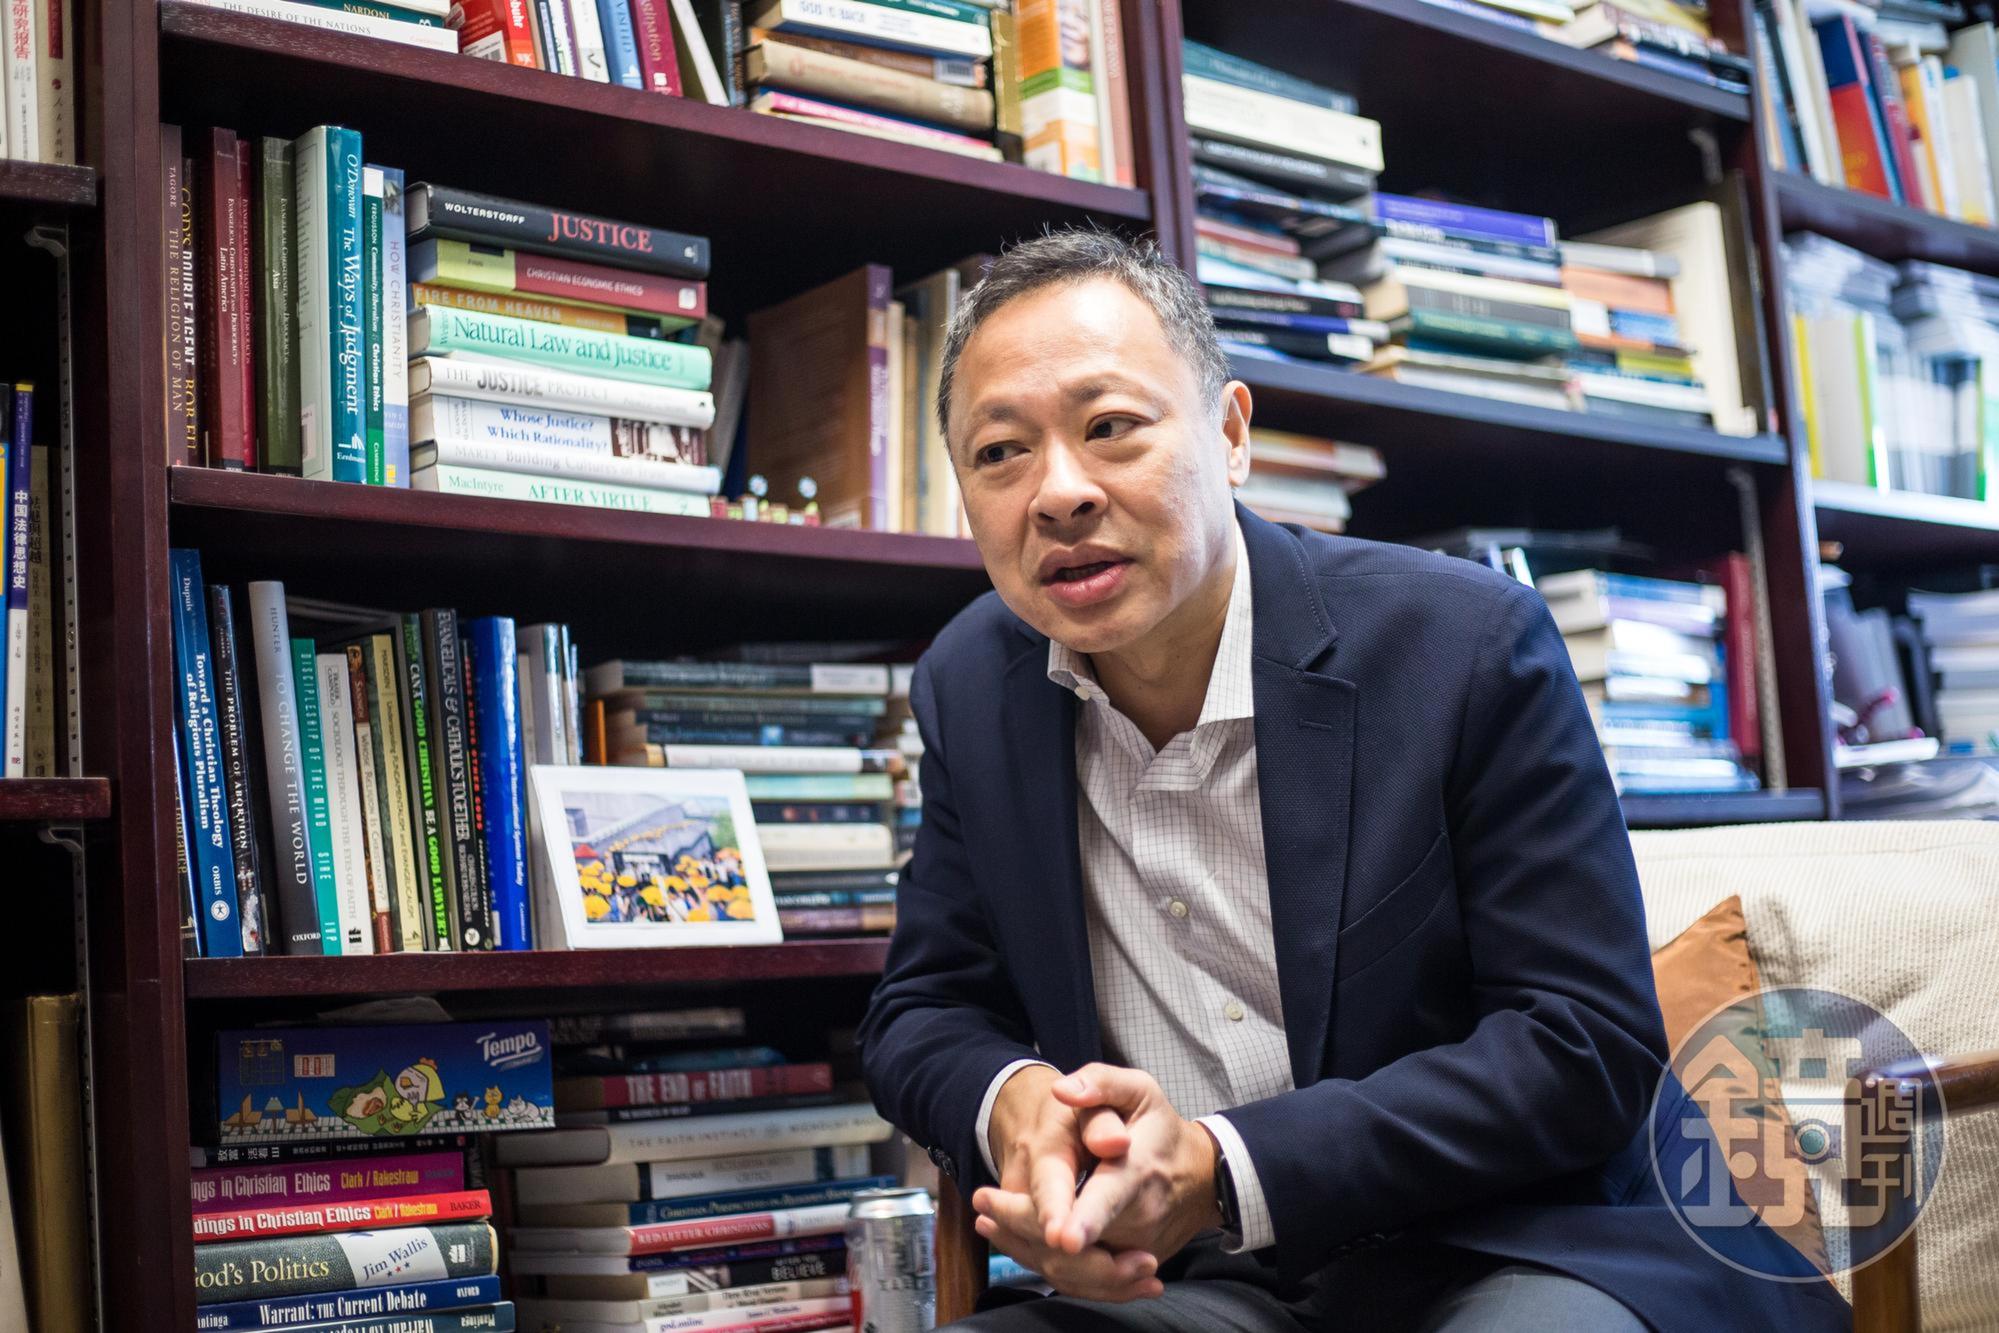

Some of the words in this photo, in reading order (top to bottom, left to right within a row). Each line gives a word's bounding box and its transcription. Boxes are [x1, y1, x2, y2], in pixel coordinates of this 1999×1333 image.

[12, 0, 31, 60] 研究报告
[222, 1, 244, 11] THE
[246, 6, 282, 20] DESIRE
[285, 12, 300, 21] OF
[302, 14, 322, 26] THE
[325, 18, 371, 35] NATIONS
[168, 165, 178, 208] TAGORE
[347, 153, 359, 218] O'Donovan
[444, 202, 525, 224] WOLTERSTORFF
[169, 228, 179, 260] THE
[343, 227, 355, 251] The
[548, 212, 653, 253] JUSTICE
[219, 247, 228, 271] Latin
[390, 241, 401, 275] HOW
[220, 273, 229, 313] America
[272, 268, 281, 289] Asia
[338, 254, 360, 302] Ways
[526, 267, 571, 284] CHRISTIAN
[572, 277, 614, 292] ECONOMIC
[614, 282, 643, 296] ETHICS
[170, 267, 181, 343] RELIGION
[345, 305, 357, 321] of
[415, 287, 451, 304] FIRE
[457, 293, 499, 310] FROM
[505, 300, 561, 320] HEAVEN
[391, 280, 402, 377] CHRISTIANITY
[453, 315, 525, 346] Natural
[530, 327, 571, 354] Law
[575, 335, 610, 360] and
[614, 342, 672, 371] Justice
[171, 350, 182, 371] OF
[338, 322, 361, 416] Judgment
[372, 343, 380, 384] Christian
[172, 376, 183, 412] MAN
[373, 385, 381, 412] Ethics
[446, 368, 471, 382] THE
[477, 370, 544, 397] JUSTICE
[499, 407, 543, 424] Whose
[546, 415, 594, 431] Justice?
[487, 425, 530, 441] Which
[533, 432, 608, 451] Rationality?
[506, 452, 560, 471] Building
[448, 474, 504, 493] MacIntyre
[528, 484, 585, 503] AFTER
[590, 491, 653, 512] VIRTUE
[13, 490, 28, 588] 中国法律思想史
[182, 577, 193, 612] Dupuis
[270, 607, 281, 654] HUNTER
[438, 612, 457, 695] EVANGELICALS
[186, 673, 197, 689] of
[195, 652, 210, 703] Toward
[224, 669, 233, 692] THE
[275, 673, 286, 694] TO
[410, 663, 421, 689] CAN
[300, 653, 319, 739] DISCIPLESHIP
[445, 697, 458, 713] &
[188, 692, 202, 757] Religious
[226, 697, 239, 757] PROBLEM
[414, 699, 426, 737] GOOD
[203, 718, 218, 783] Christian
[278, 701, 296, 775] CHANGE
[308, 747, 321, 761] OF
[332, 711, 343, 768] SOCIOLOGY
[446, 715, 464, 781] CATHOLICS
[232, 761, 241, 777] OF
[311, 769, 323, 790] THE
[381, 649, 391, 689] MARSDEN
[390, 755, 406, 831] FUNDAMENTALISM
[400, 848, 415, 919] EVANGELICALISM
[418, 740, 433, 807] CHRISTIAN
[194, 760, 208, 829] Pluralism
[286, 781, 301, 814] THE
[337, 771, 348, 823] THROUGH
[209, 786, 224, 848] Theology
[234, 781, 247, 850] ABORTION
[313, 797, 327, 827] MIND
[425, 809, 435, 825] BE
[452, 781, 470, 842] TOGETHER
[341, 825, 351, 846] THE
[427, 824, 437, 835] A
[291, 821, 307, 885] WORLD
[317, 852, 331, 880] SIRE
[344, 848, 354, 872] EYES
[428, 836, 441, 874] GOOD
[211, 865, 222, 896] ORBIS
[346, 873, 355, 887] OF
[515, 861, 524, 887] Today
[347, 889, 357, 919] FAITH
[432, 877, 447, 936] LAWYER?
[292, 931, 321, 942] OXFORD
[476, 1031, 536, 1062] Tempo
[221, 1175, 233, 1198] in
[235, 1173, 287, 1197] Christian
[295, 1171, 331, 1194] Ethics
[340, 1171, 364, 1189] Clark
[373, 1168, 419, 1187] Rakestraw
[193, 1217, 236, 1236] dings
[238, 1215, 254, 1233] in
[256, 1211, 324, 1229] Christian
[326, 1206, 371, 1224] Ethics
[374, 1206, 393, 1219] Clark
[400, 1203, 438, 1217] Rakestraw
[450, 1199, 482, 1212] BAKER
[251, 1257, 329, 1284] Politics
[362, 1260, 388, 1281] Jim
[387, 1237, 429, 1267] Wallis
[259, 1303, 315, 1326] Warrant:
[316, 1301, 335, 1317] THE
[337, 1294, 383, 1315] Current
[386, 1288, 428, 1310] Debate
[457, 1286, 480, 1297] OXFORD
